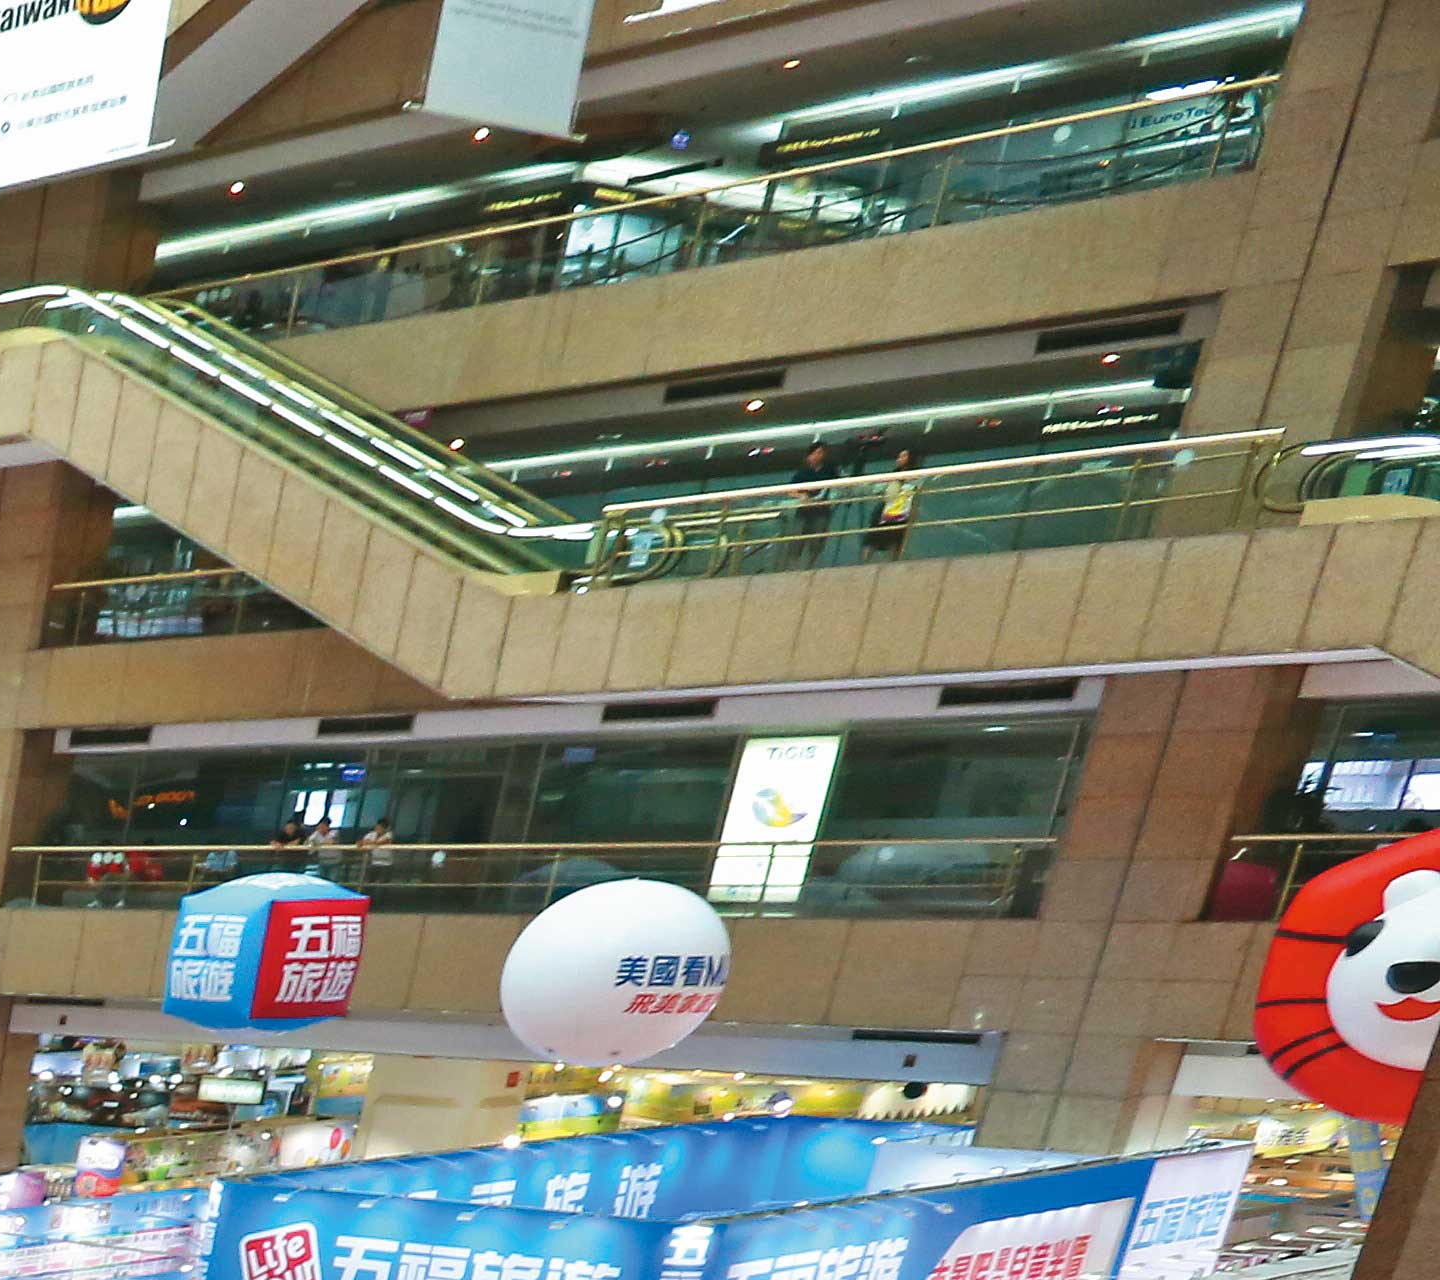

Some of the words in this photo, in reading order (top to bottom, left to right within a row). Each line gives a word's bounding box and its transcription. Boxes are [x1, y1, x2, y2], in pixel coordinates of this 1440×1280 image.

[180, 914, 247, 959] 五福
[286, 914, 363, 960] 五福
[170, 957, 237, 1004] 旅遊
[275, 958, 358, 1004] 旅遊
